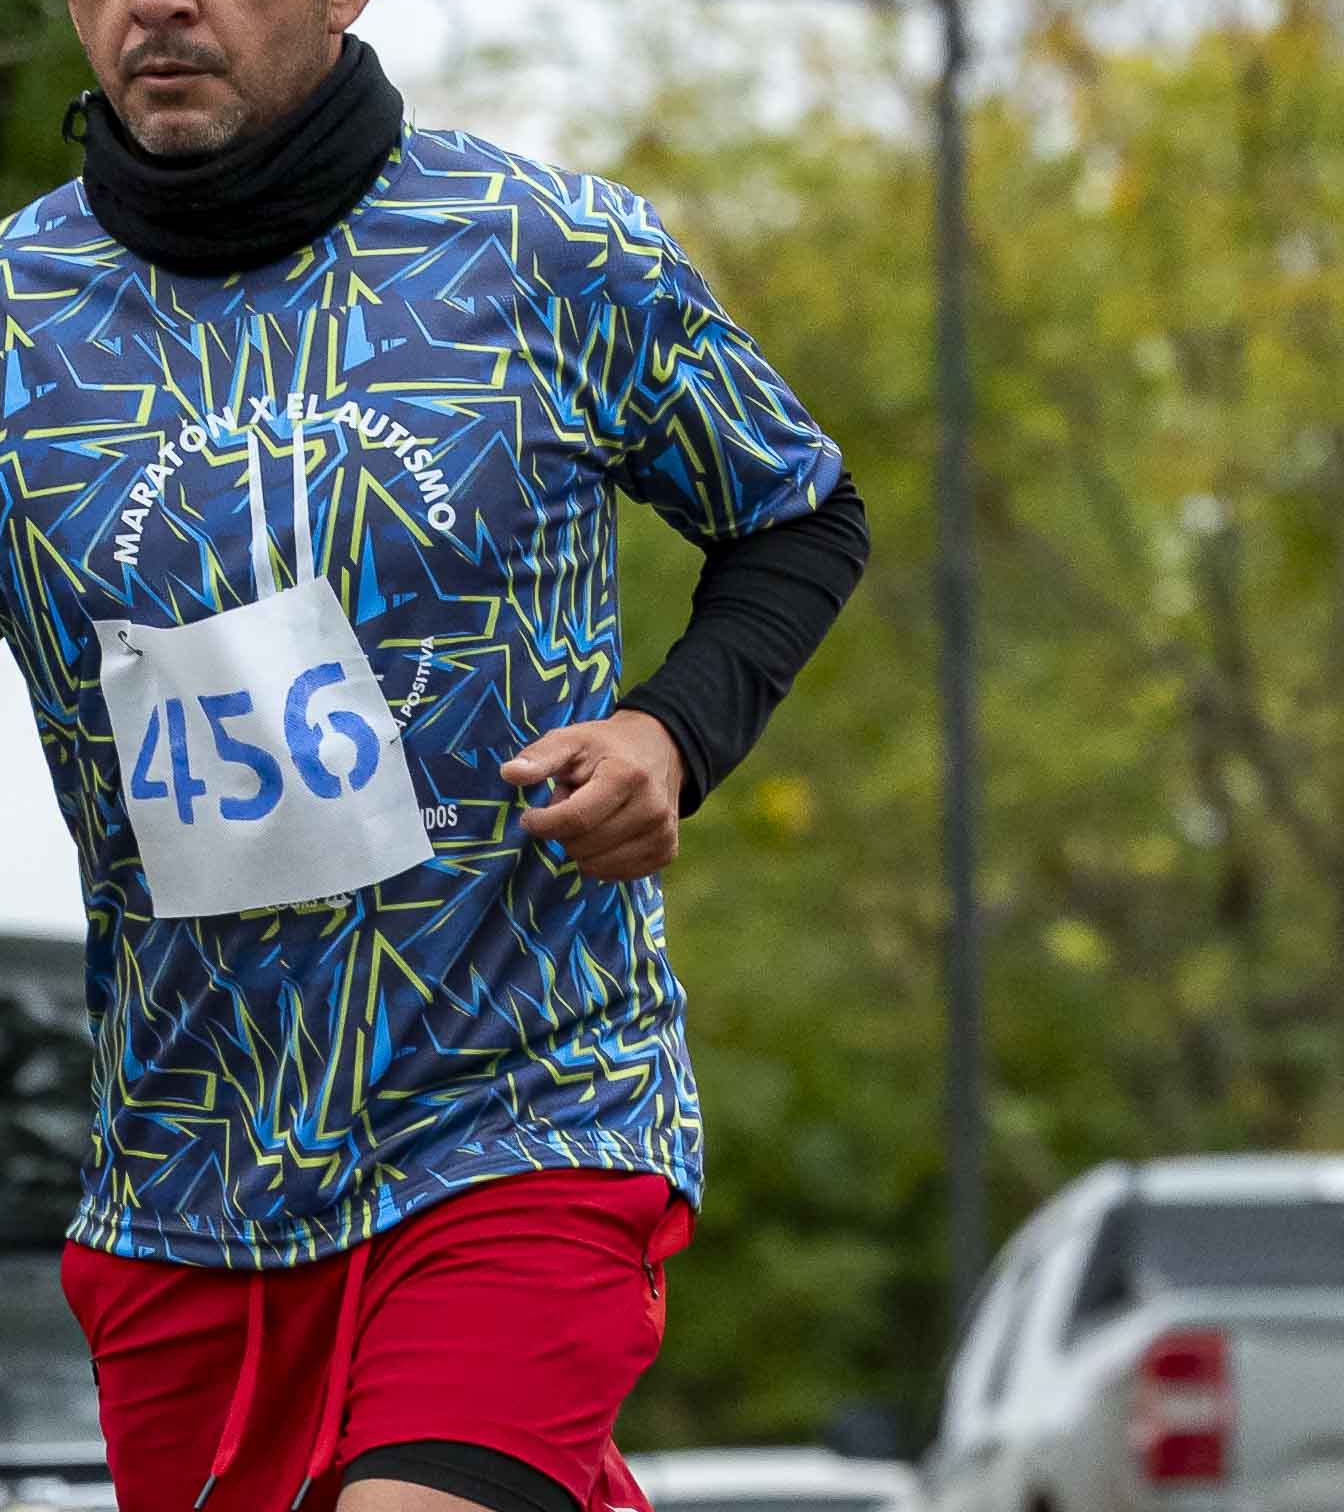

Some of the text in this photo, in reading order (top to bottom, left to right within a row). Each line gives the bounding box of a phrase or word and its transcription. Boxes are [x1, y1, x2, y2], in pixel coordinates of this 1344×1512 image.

[248, 394, 275, 425] X
[287, 392, 323, 421] EL
[332, 400, 456, 531] AUTISMO
[130, 661, 381, 825] 456
[400, 635, 435, 718] POSITIVA
